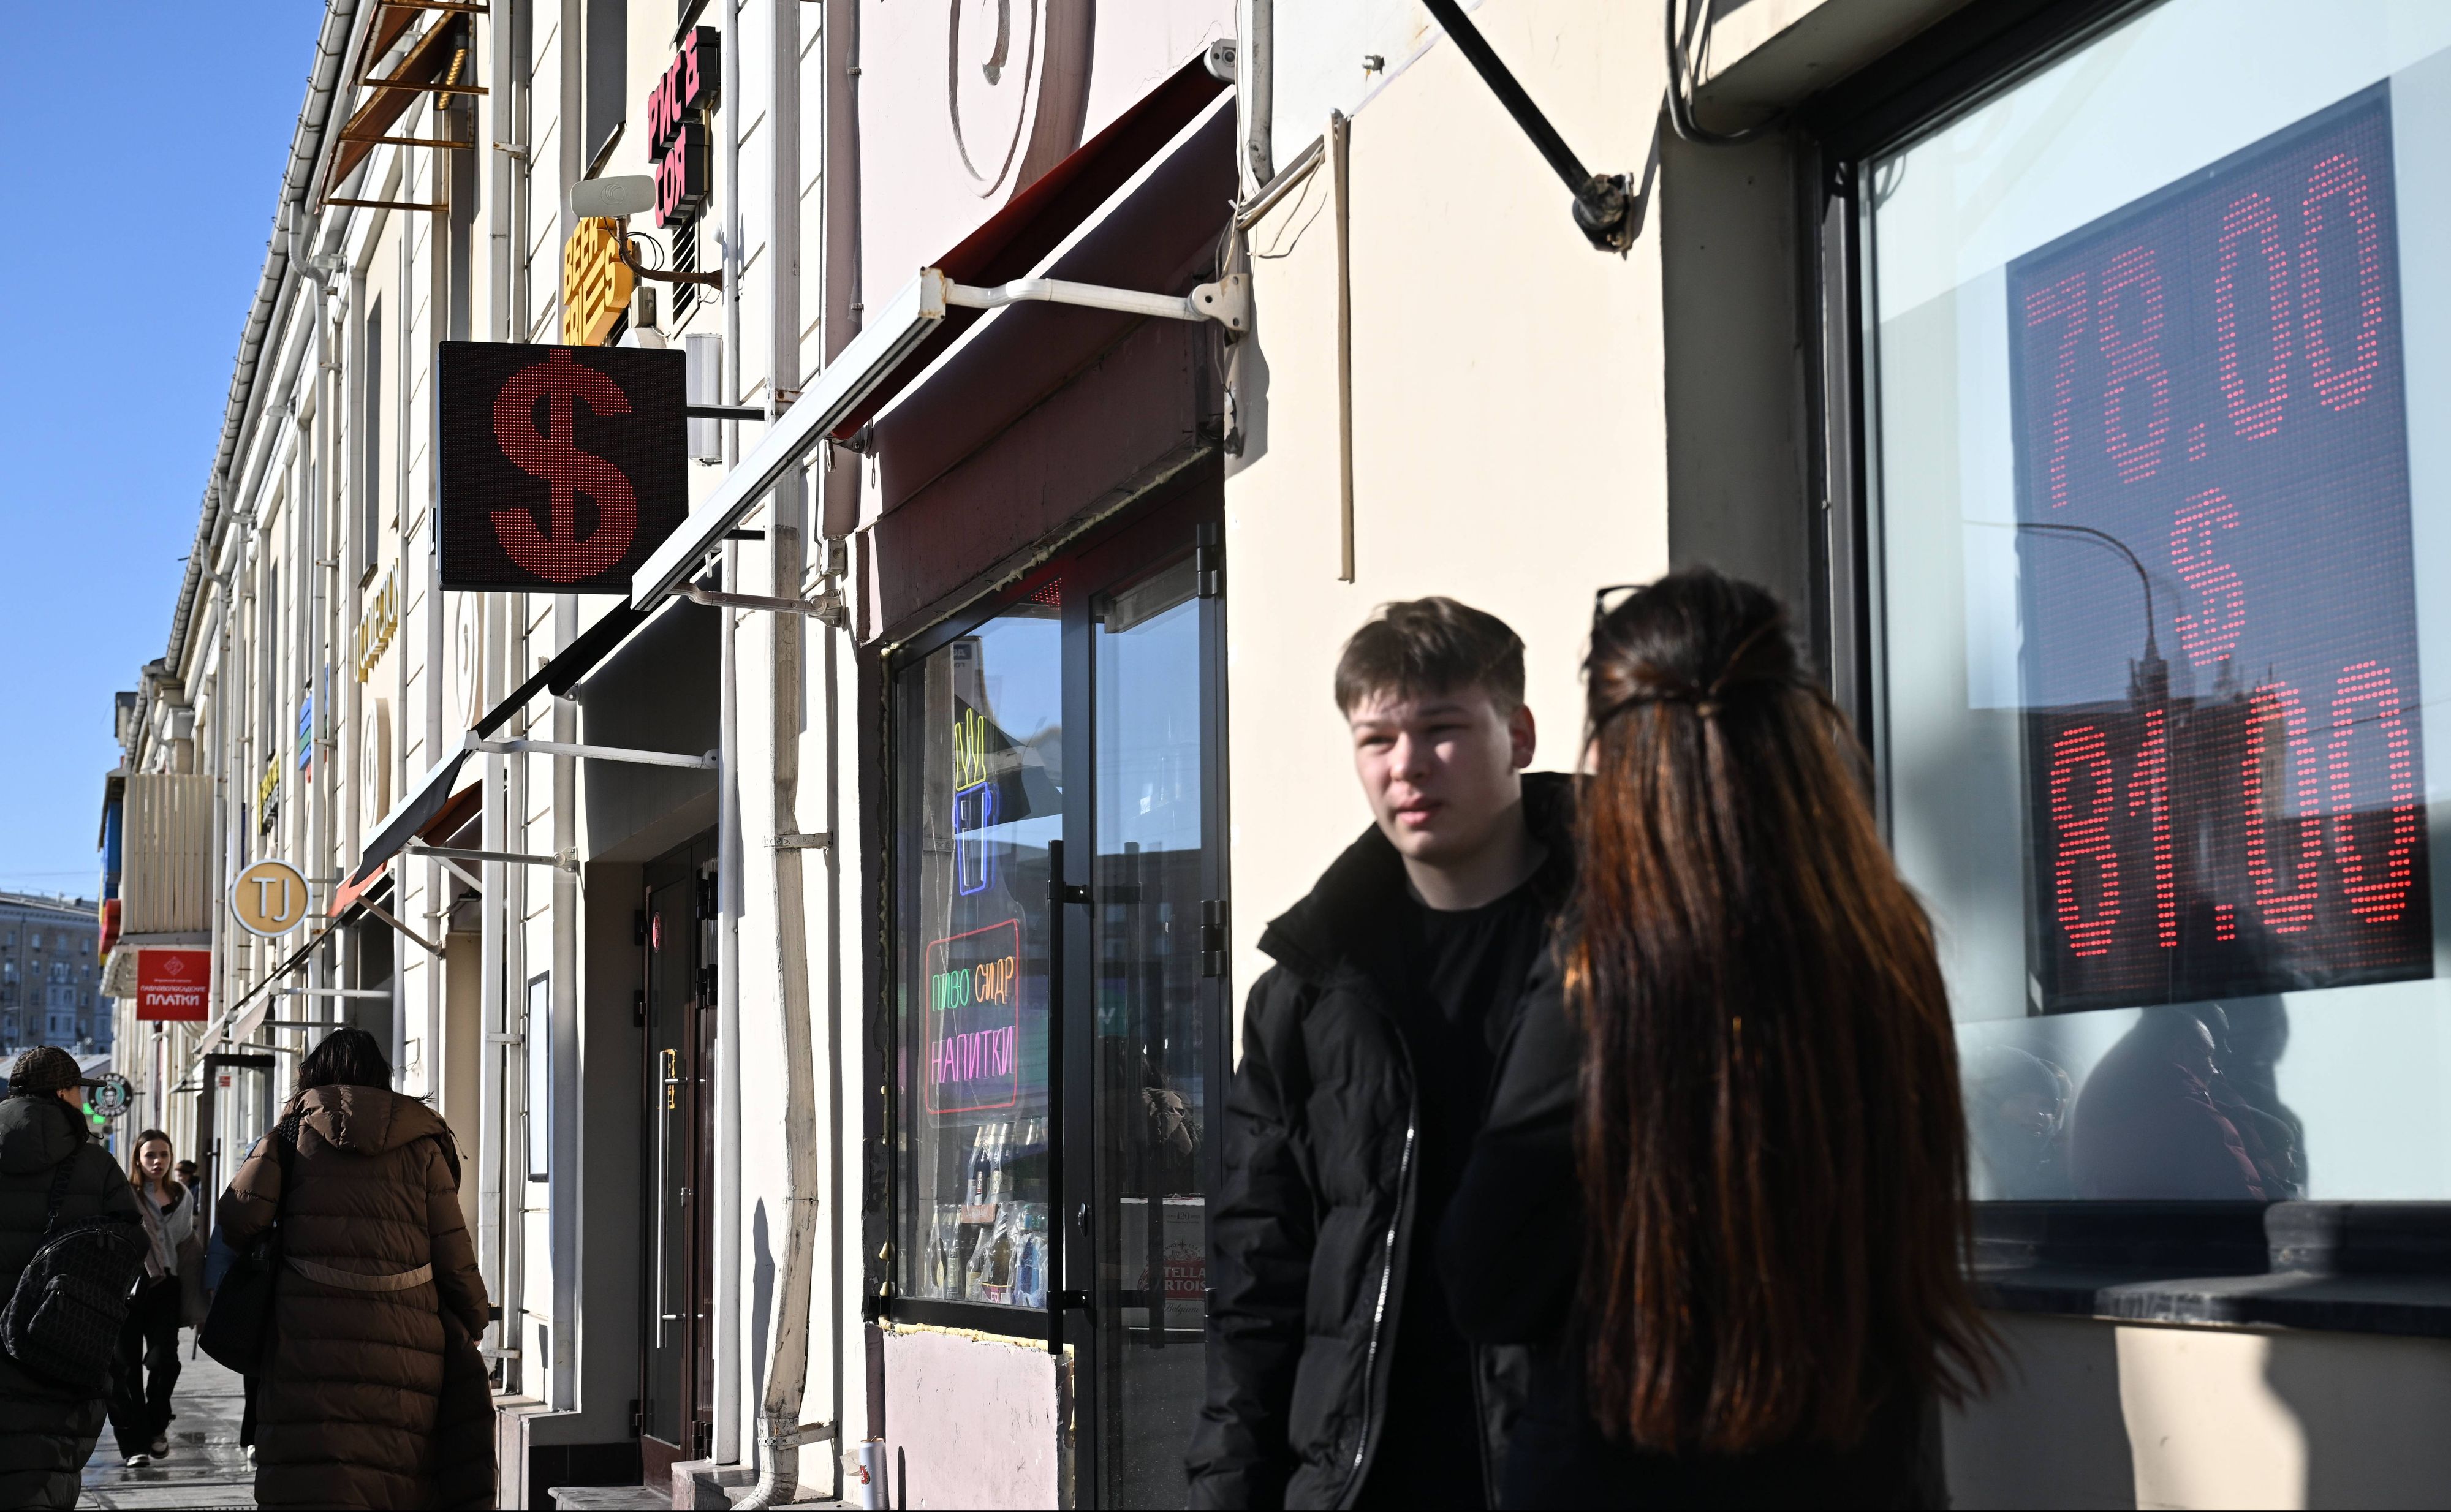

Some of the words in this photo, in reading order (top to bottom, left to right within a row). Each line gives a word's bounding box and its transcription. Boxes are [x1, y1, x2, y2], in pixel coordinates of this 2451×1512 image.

[655, 122, 685, 229] СОЯ
[2025, 153, 2382, 509] 78.00
[491, 348, 638, 583] $
[2170, 487, 2245, 666] $
[2050, 659, 2417, 958] 81.00
[251, 877, 290, 922] TJ
[146, 993, 200, 1006] ПЛАТКИ
[932, 968, 970, 1012] ПИВО
[974, 956, 1015, 1006] СИДР
[931, 1026, 1013, 1086] НАПИТКИ
[1164, 1266, 1206, 1279] TELLA
[1164, 1280, 1206, 1292] RTOIS
[1164, 1302, 1199, 1316] Belgium
